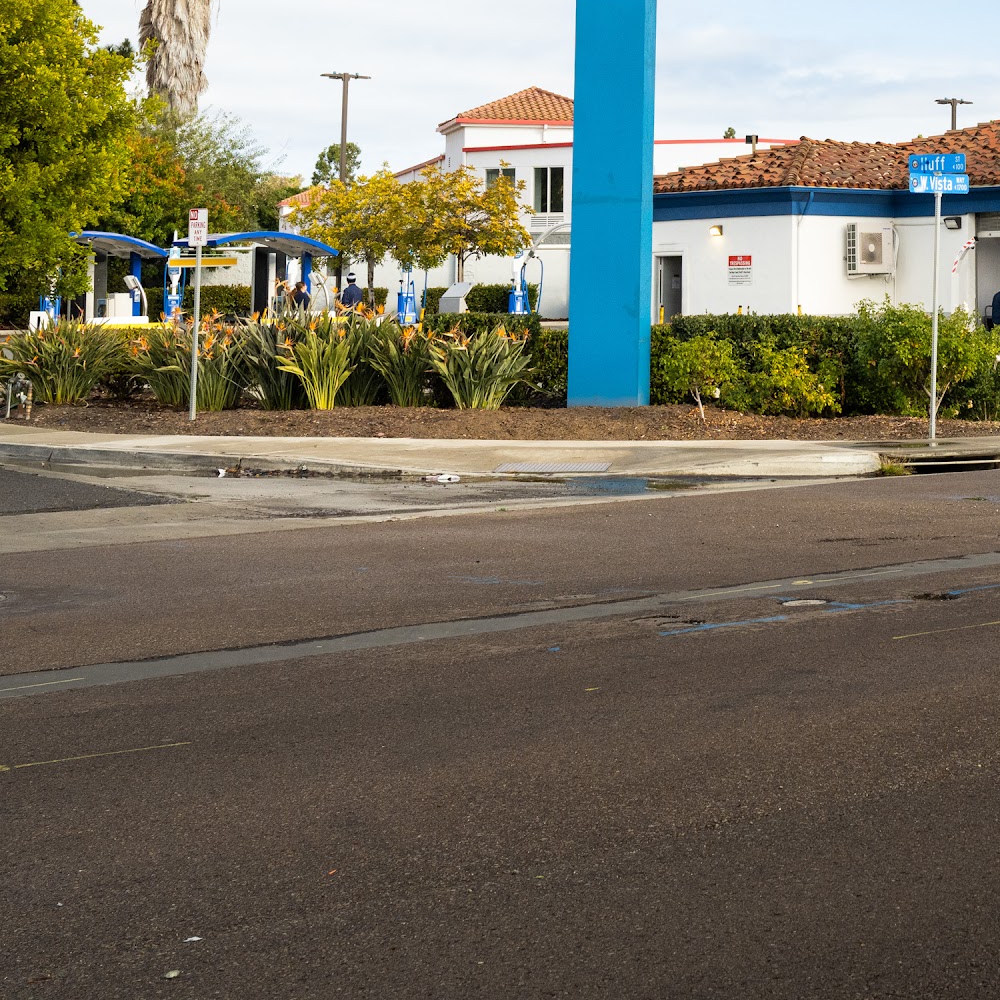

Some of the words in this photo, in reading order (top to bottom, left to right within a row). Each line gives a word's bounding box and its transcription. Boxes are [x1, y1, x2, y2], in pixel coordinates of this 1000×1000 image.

[920, 156, 946, 171] Huff
[920, 175, 929, 191] W.
[930, 175, 953, 191] Vista
[190, 210, 198, 219] NO
[191, 221, 206, 229] PARKING
